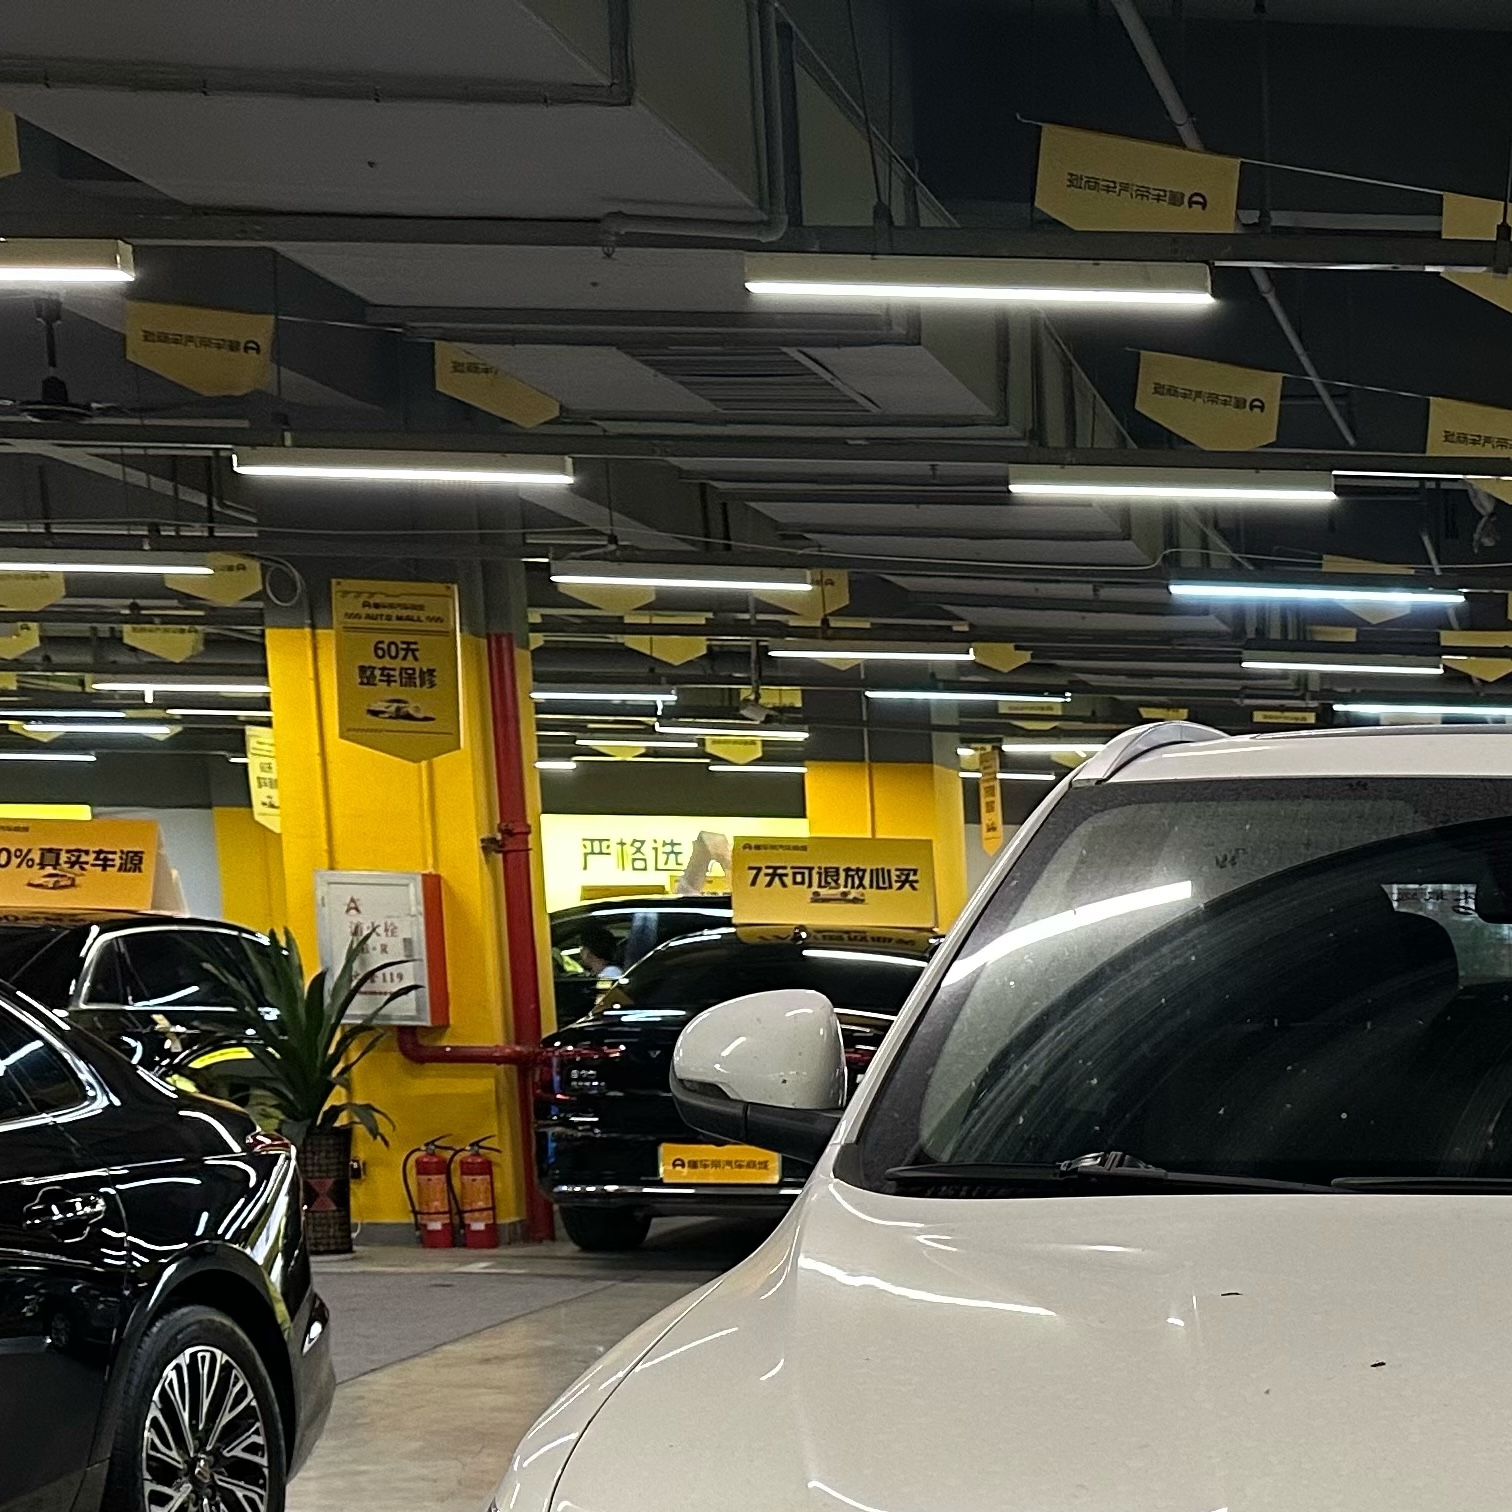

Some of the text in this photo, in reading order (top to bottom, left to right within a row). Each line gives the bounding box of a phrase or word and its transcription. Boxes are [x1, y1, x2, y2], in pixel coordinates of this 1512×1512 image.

[373, 640, 420, 662] 60天
[357, 665, 438, 689] 整车保修
[747, 865, 920, 891] 7天可退放心买
